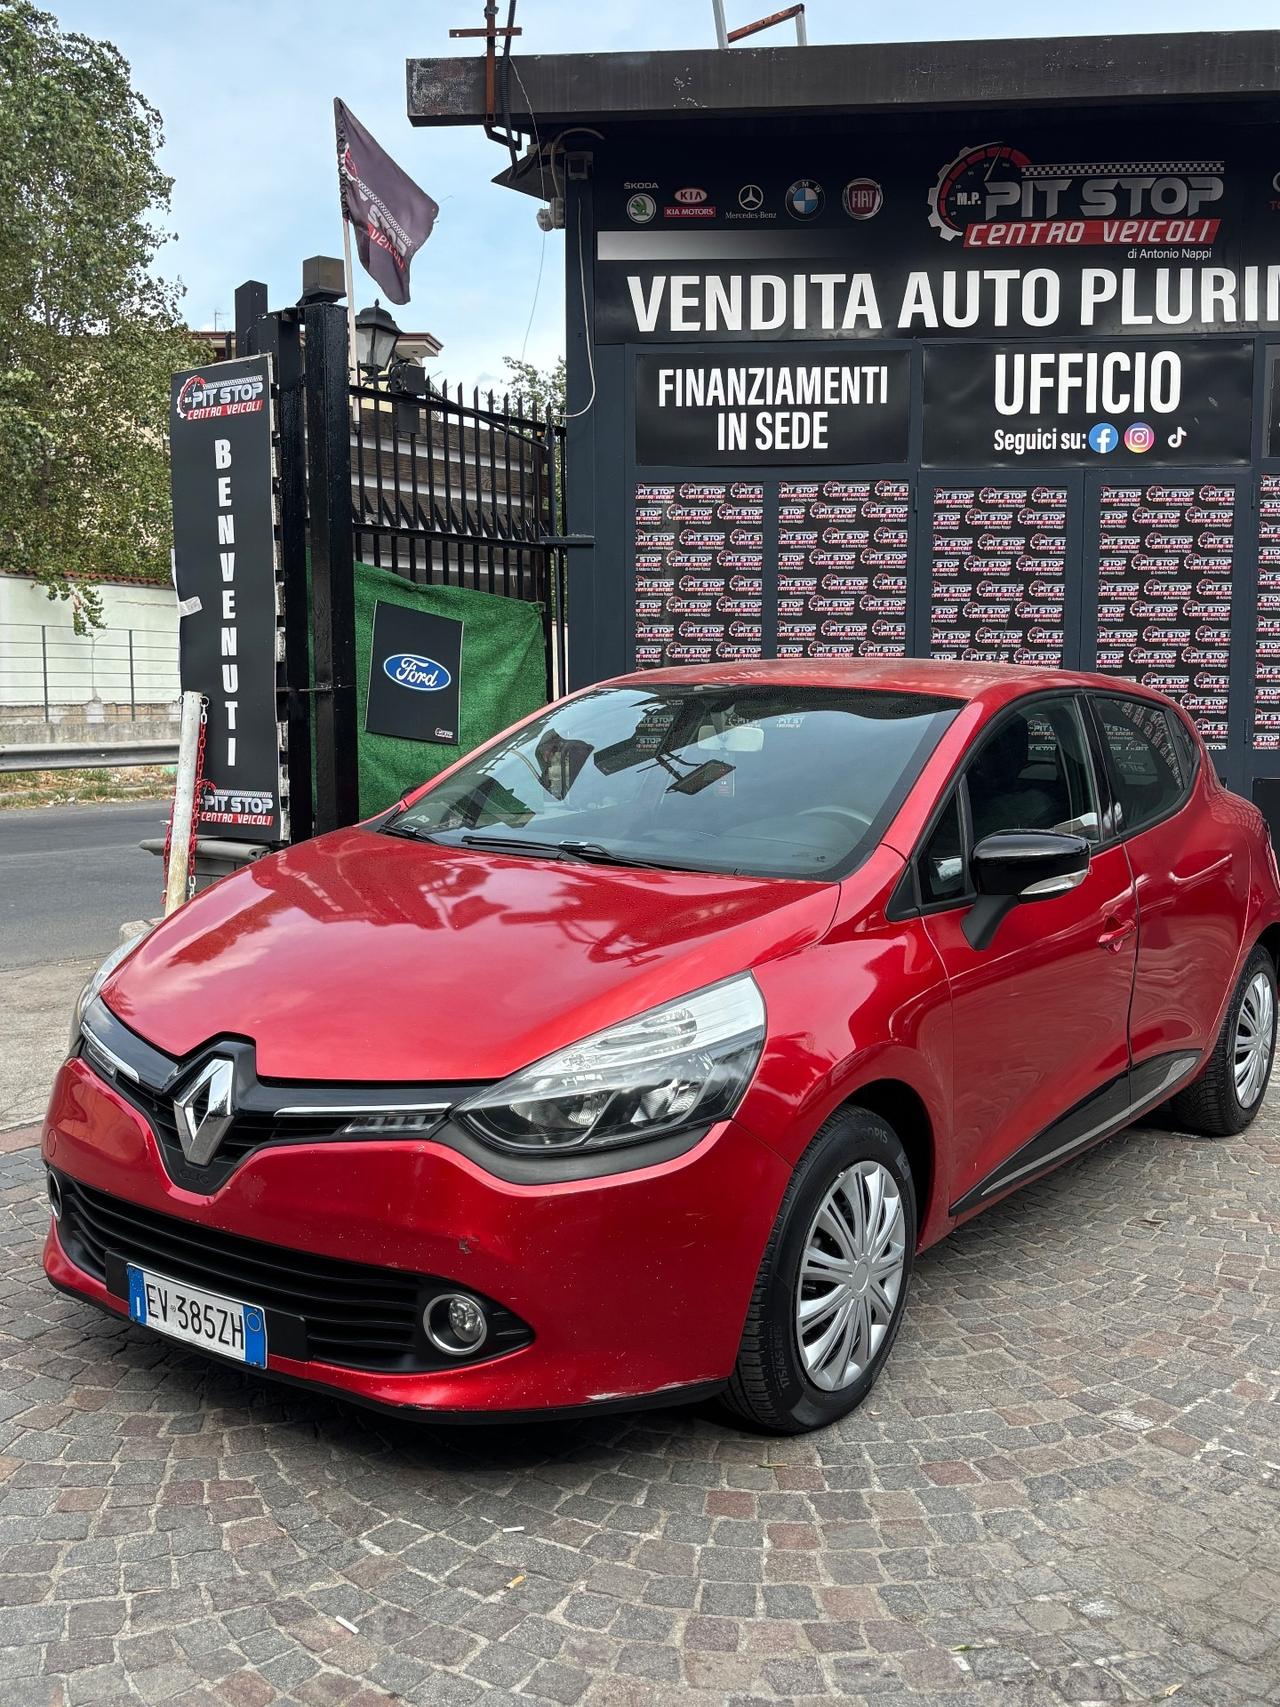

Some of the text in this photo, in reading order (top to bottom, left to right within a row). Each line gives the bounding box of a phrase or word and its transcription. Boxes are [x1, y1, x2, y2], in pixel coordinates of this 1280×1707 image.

[789, 181, 822, 194] BMW
[680, 191, 702, 201] KIA
[852, 190, 875, 208] FIAT
[956, 192, 981, 206] M.P.
[984, 176, 1224, 220] PIT STOP
[666, 208, 714, 216] KIA MOTORS
[725, 211, 777, 219] Mercedes-Benz
[968, 220, 1211, 246] CENTRO VEICOLI
[1127, 247, 1212, 261] di Antonio Nappi
[627, 273, 882, 332] VENDITA
[897, 268, 1060, 328] AUTO
[658, 366, 887, 407] FINANZIAMENTI
[995, 350, 1182, 416] UFFICIO
[192, 382, 263, 409] PIT STOP
[717, 411, 829, 451] IN SEDE
[993, 427, 1087, 455] Seguici su:
[637, 488, 675, 496] PIT STOP
[780, 487, 818, 495] PIT STOP
[832, 486, 870, 494] PIT STOP
[1155, 490, 1194, 498] PIT STOP
[988, 492, 1027, 500] PIT STOP
[1102, 491, 1142, 499] PIT STOP
[675, 509, 712, 517] PIT STOP
[818, 508, 856, 516] PIT STOP
[1141, 512, 1180, 520] PIT STOP
[1194, 511, 1233, 519] PIT STOP
[1026, 513, 1065, 521] PIT STOP
[688, 534, 725, 542] PIT STOP
[780, 534, 817, 542] PIT STOP
[831, 533, 869, 541] PIT STOP
[1154, 537, 1193, 545] PIT STOP
[951, 539, 973, 547] STOP
[986, 539, 1025, 547] PIT STOP
[1101, 538, 1140, 546] PIT STOP
[725, 555, 762, 563] PIT STOP
[818, 554, 833, 562] PIT
[869, 554, 907, 562] PIT STOP
[973, 560, 1012, 568] PIT STOP
[1025, 560, 1064, 568] PIT STOP
[1140, 559, 1179, 567] PIT STOP
[687, 580, 725, 588] PIT STOP
[1100, 584, 1139, 592] PIT STOP
[1153, 584, 1192, 592] PIT STOP
[933, 586, 972, 594] PIT STOP
[214, 439, 238, 766] BENVENUTI
[675, 601, 712, 609] PIT STOP
[725, 601, 762, 609] PIT STOP
[833, 601, 854, 609] STOP
[971, 607, 1010, 615] PIT STOP
[637, 626, 674, 634] PIT STOP
[687, 626, 724, 634] PIT STOP
[779, 626, 816, 634] PIT STOP
[932, 632, 971, 640] PIT STOP
[1099, 631, 1138, 639] PIT STOP
[1151, 631, 1191, 639] PIT STOP
[674, 647, 712, 655] PIT STOP
[1022, 653, 1061, 661] PIT STOP
[1137, 652, 1177, 660] PIT STOP
[396, 657, 438, 688] Ford
[1150, 677, 1189, 685] PIT STOP
[203, 794, 274, 815] PIT STOP
